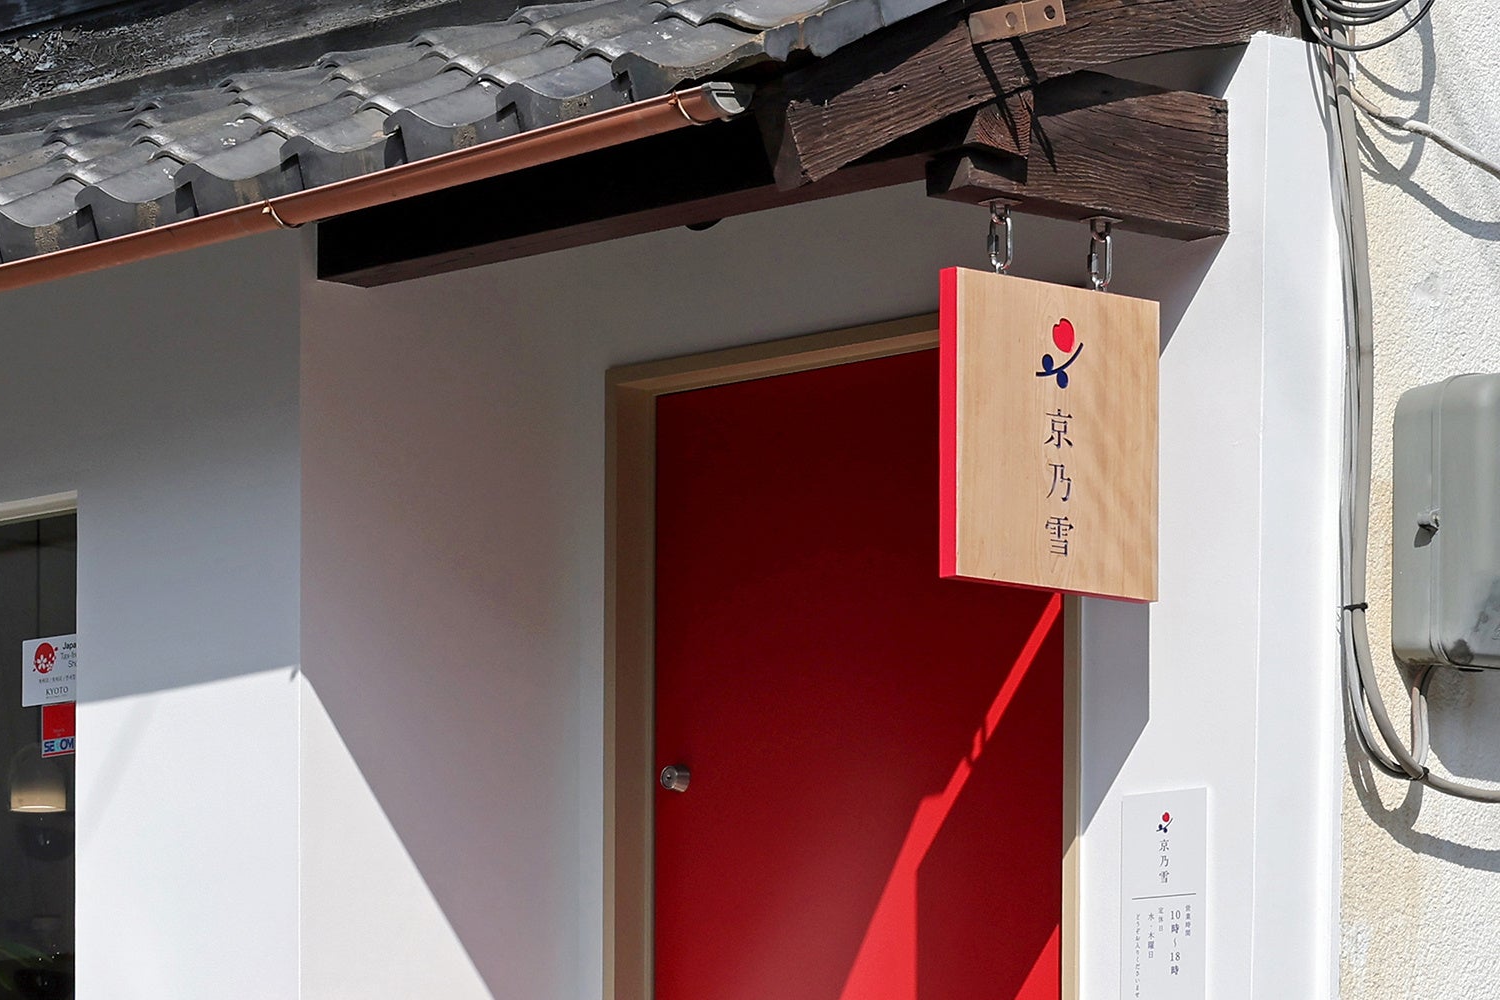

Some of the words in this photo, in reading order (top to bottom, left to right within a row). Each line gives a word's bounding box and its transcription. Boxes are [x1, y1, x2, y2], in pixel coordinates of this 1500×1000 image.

[1044, 408, 1074, 557] 京乃雪
[62, 642, 77, 650] Japa
[45, 686, 69, 696] KYOTO
[44, 738, 74, 753] SECOM
[1159, 839, 1169, 883] 京乃雪
